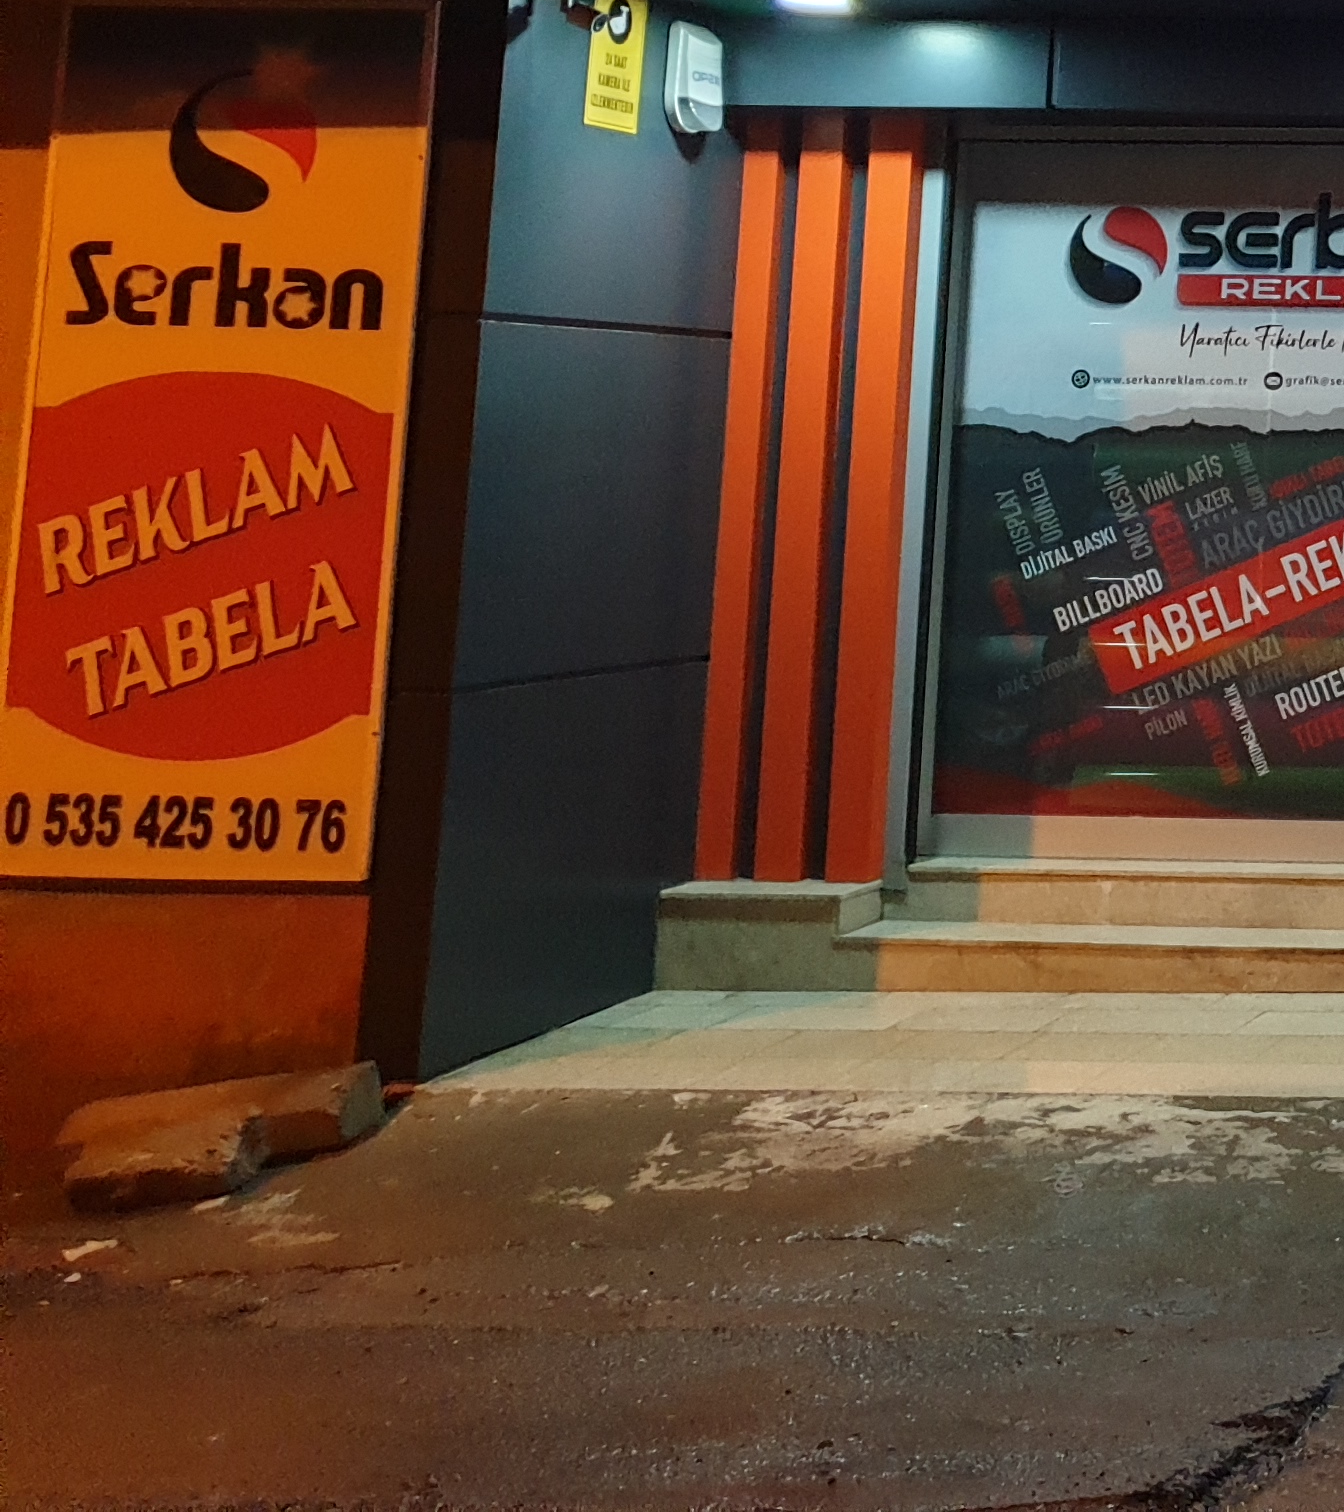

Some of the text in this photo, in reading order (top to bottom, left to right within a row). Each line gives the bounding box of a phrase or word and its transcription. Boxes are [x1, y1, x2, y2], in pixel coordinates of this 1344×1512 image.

[64, 240, 384, 332] Serkan
[1093, 374, 1249, 387] www.serkanreklam.com.tr
[37, 422, 354, 597] REKLAM
[1138, 453, 1224, 507] VİNİL AFİŞ
[1184, 486, 1236, 520] LAZER
[993, 489, 1036, 556] DISPLAY
[1100, 464, 1154, 562] CNC KESİM
[1201, 518, 1266, 570] ARAÇ
[1020, 525, 1118, 580] DİJİTAL BASKI
[1052, 568, 1164, 633] BILLBOARD
[65, 560, 358, 718] TABELA
[1131, 633, 1283, 716] LED KAYAN YAZI
[1144, 707, 1188, 741] PİLON
[1239, 718, 1270, 777] KURUMSAL
[4, 792, 346, 854] 0 535 425 30 76
